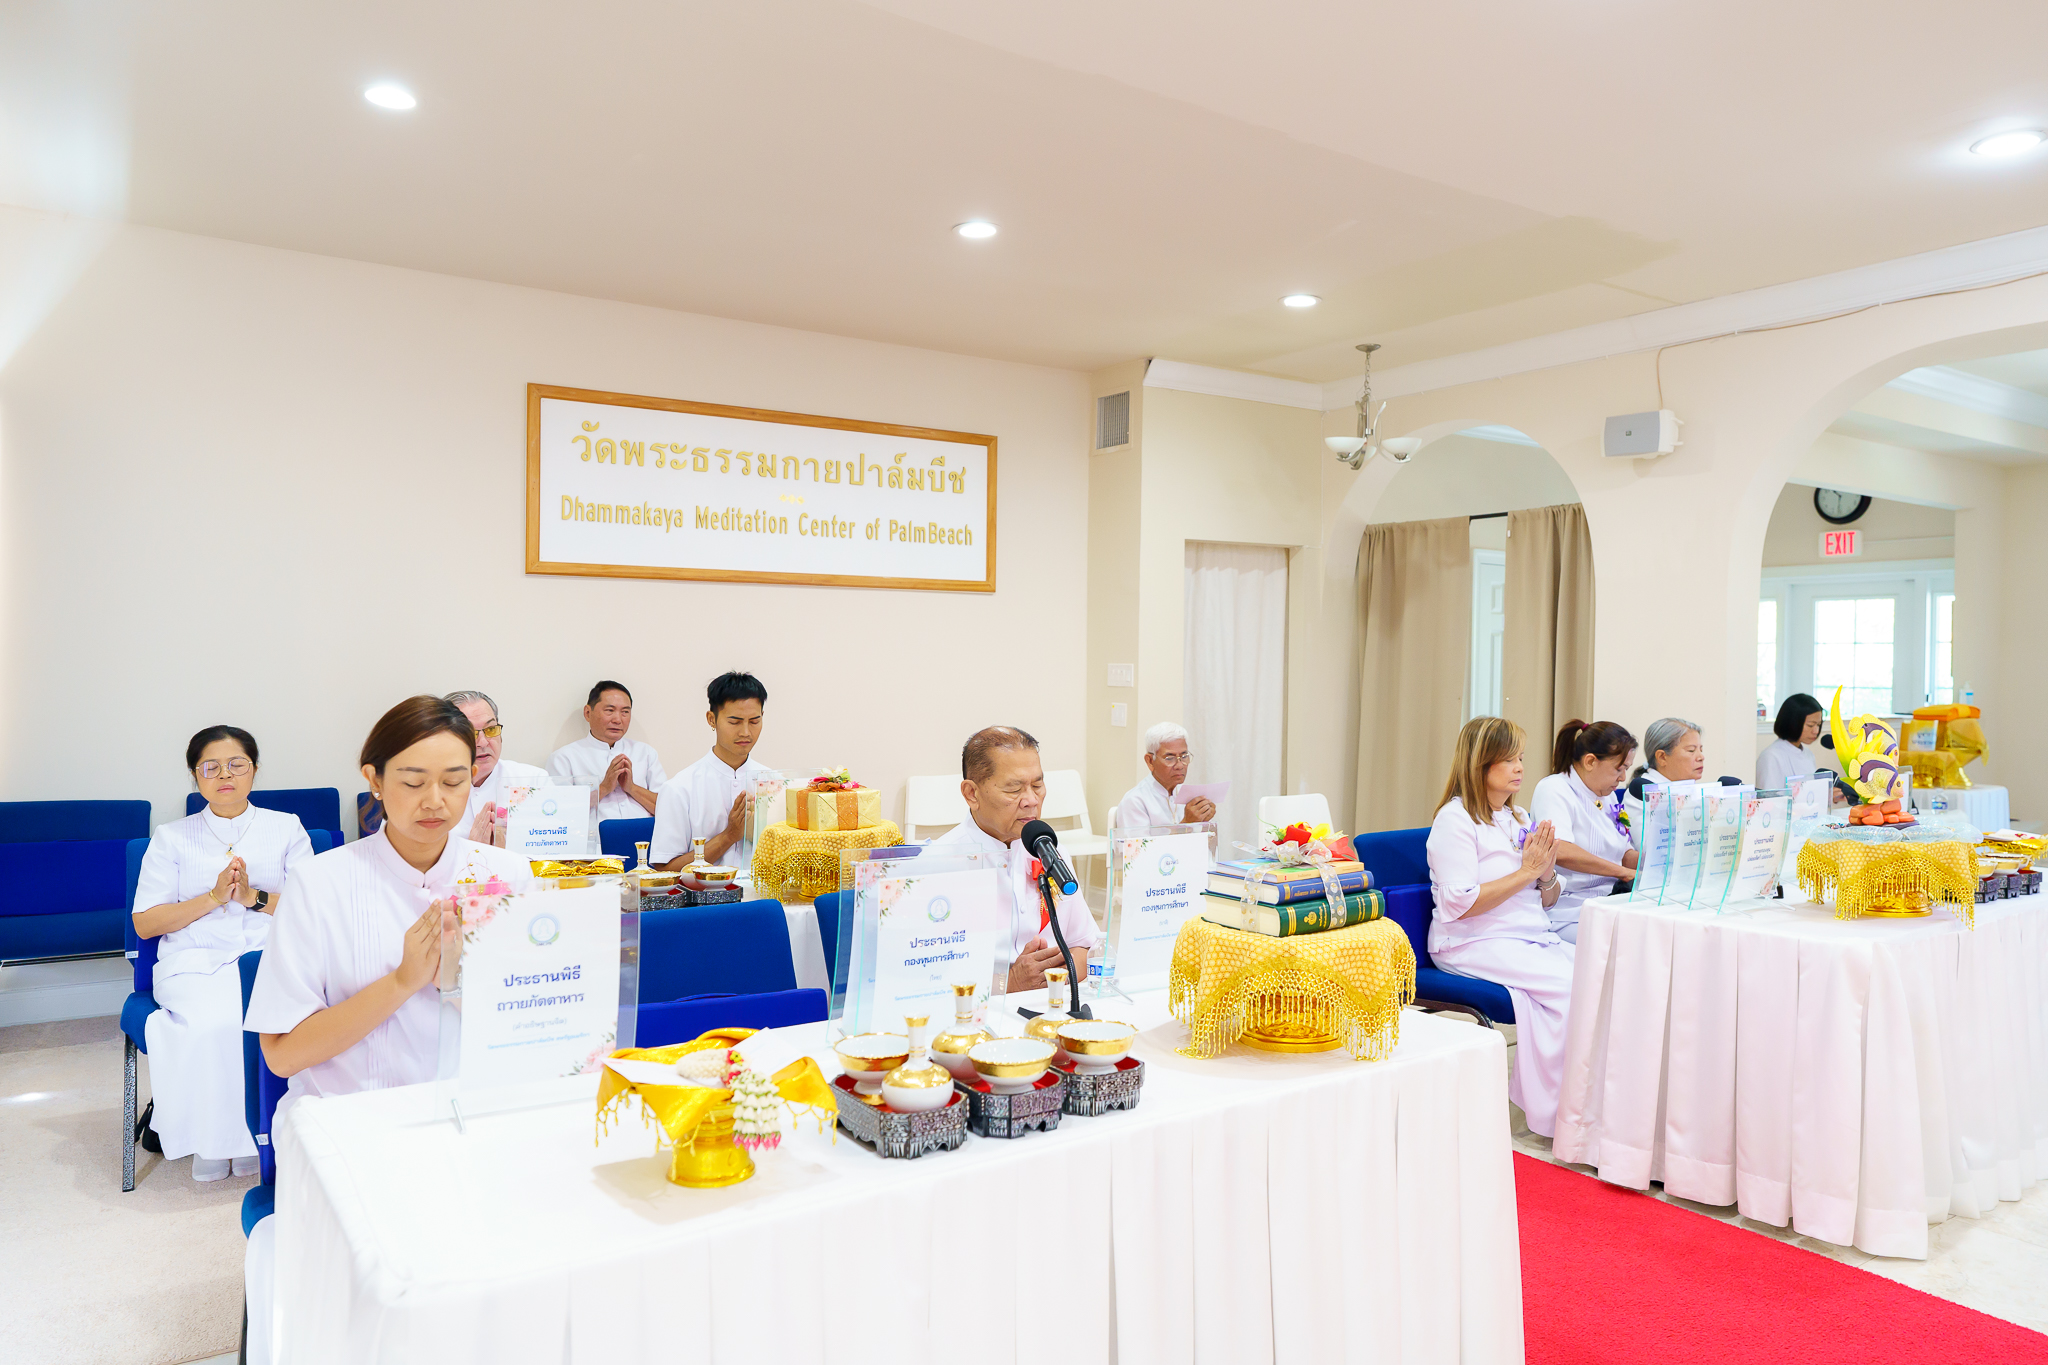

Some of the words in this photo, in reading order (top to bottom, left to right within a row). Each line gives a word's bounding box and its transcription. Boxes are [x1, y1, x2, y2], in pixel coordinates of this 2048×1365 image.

[572, 420, 967, 494] วัดพระธรรมกายปาล์มบีช
[561, 495, 684, 533] Dhammakaya
[695, 505, 788, 535] Meditation
[799, 512, 856, 539] Center
[866, 518, 880, 541] of
[889, 519, 973, 546] PalmBeach
[1825, 531, 1856, 556] EXIT
[528, 826, 568, 836] ประธานพิธี
[1145, 882, 1187, 898] ประธานพิธี
[1141, 899, 1189, 914] กองทุนการศึกษา
[909, 929, 966, 949] ประธานพิธี
[904, 949, 970, 968] กองทุนการศึกษา
[503, 964, 581, 987] ประธานพิธี
[497, 993, 585, 1012] ถวายภัตตาหาร
